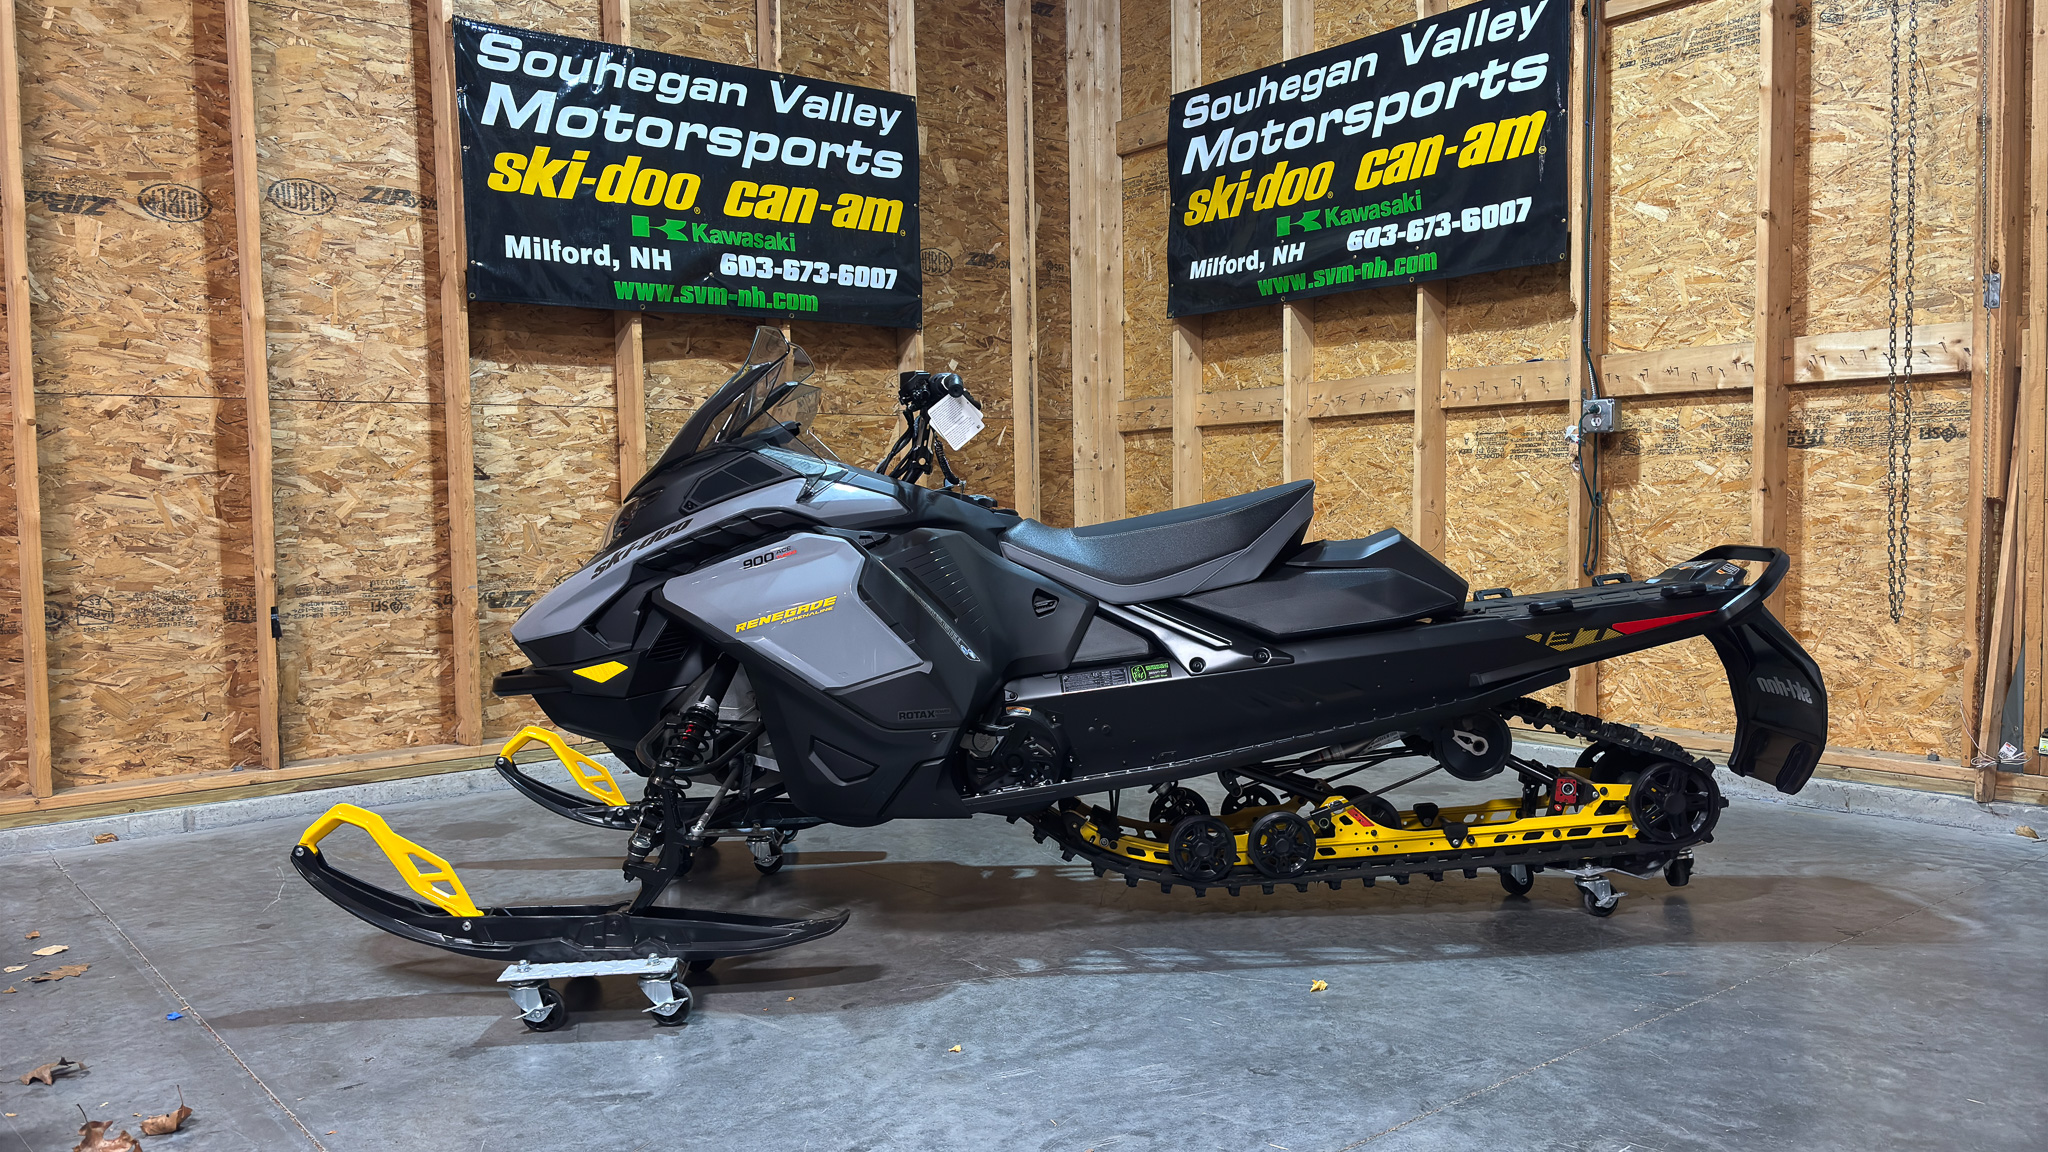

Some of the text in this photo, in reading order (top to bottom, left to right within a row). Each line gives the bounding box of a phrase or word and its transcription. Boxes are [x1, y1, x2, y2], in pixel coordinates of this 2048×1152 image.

[1182, 51, 1378, 129] Souhegan
[1400, 0, 1551, 68] Valley
[476, 32, 902, 137] Souhegan Valley
[480, 81, 904, 179] Motorsports
[1181, 52, 1550, 176] Motorsports
[1183, 159, 1335, 228] ski-doo
[1353, 109, 1548, 192] can-am
[487, 145, 904, 235] ski-doo can-am
[1325, 189, 1422, 229] Kawasaki
[692, 222, 796, 252] Kawasaki
[1346, 196, 1533, 252] 603-673-6007
[504, 234, 672, 273] Milford, NH
[720, 253, 898, 290] 603-673-6007
[1189, 241, 1306, 280] Milford, NH
[1257, 249, 1438, 297] www.svm-nh.com
[613, 278, 819, 312] www.svm-nh.com
[743, 552, 774, 570] 900
[735, 595, 838, 633] RENEGADE
[780, 606, 835, 624] ADRENALINE
[899, 710, 935, 720] ROTAX
